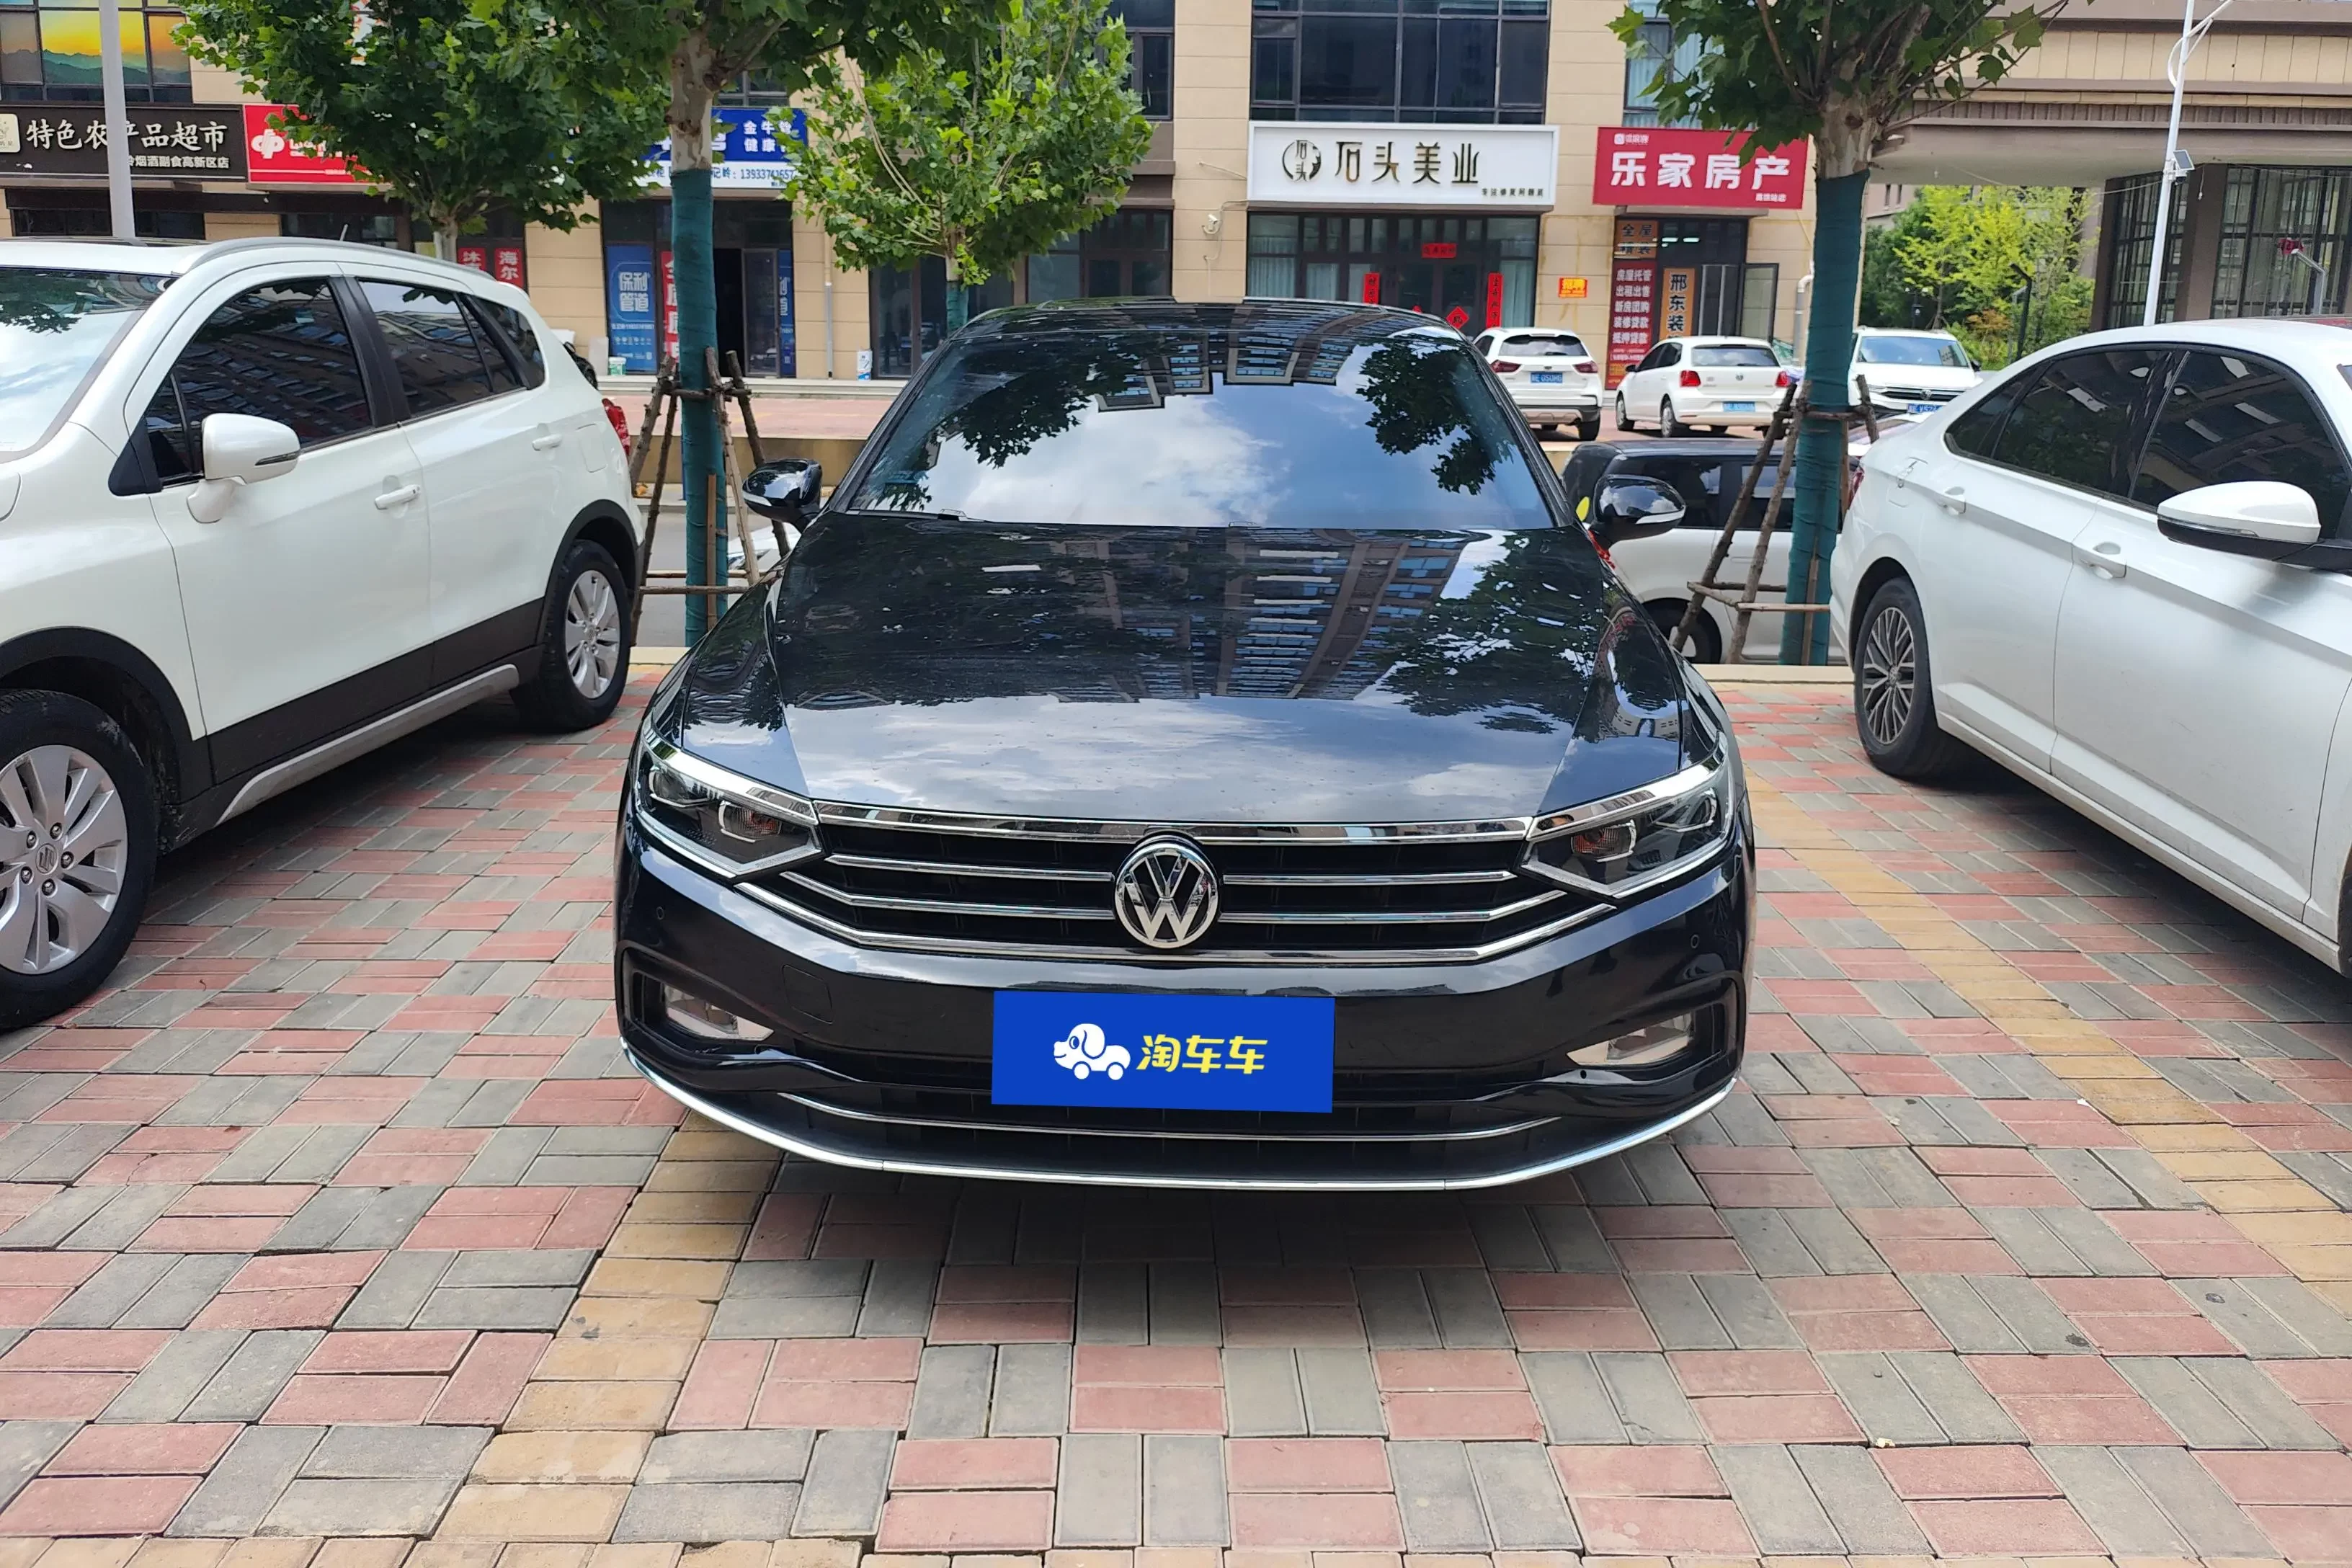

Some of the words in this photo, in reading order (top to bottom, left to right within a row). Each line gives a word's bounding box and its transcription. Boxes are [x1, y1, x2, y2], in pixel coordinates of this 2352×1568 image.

[1335, 141, 1479, 184] 石头美业
[1611, 151, 1790, 190] 乐家房产
[1667, 273, 1688, 339] 邢东装
